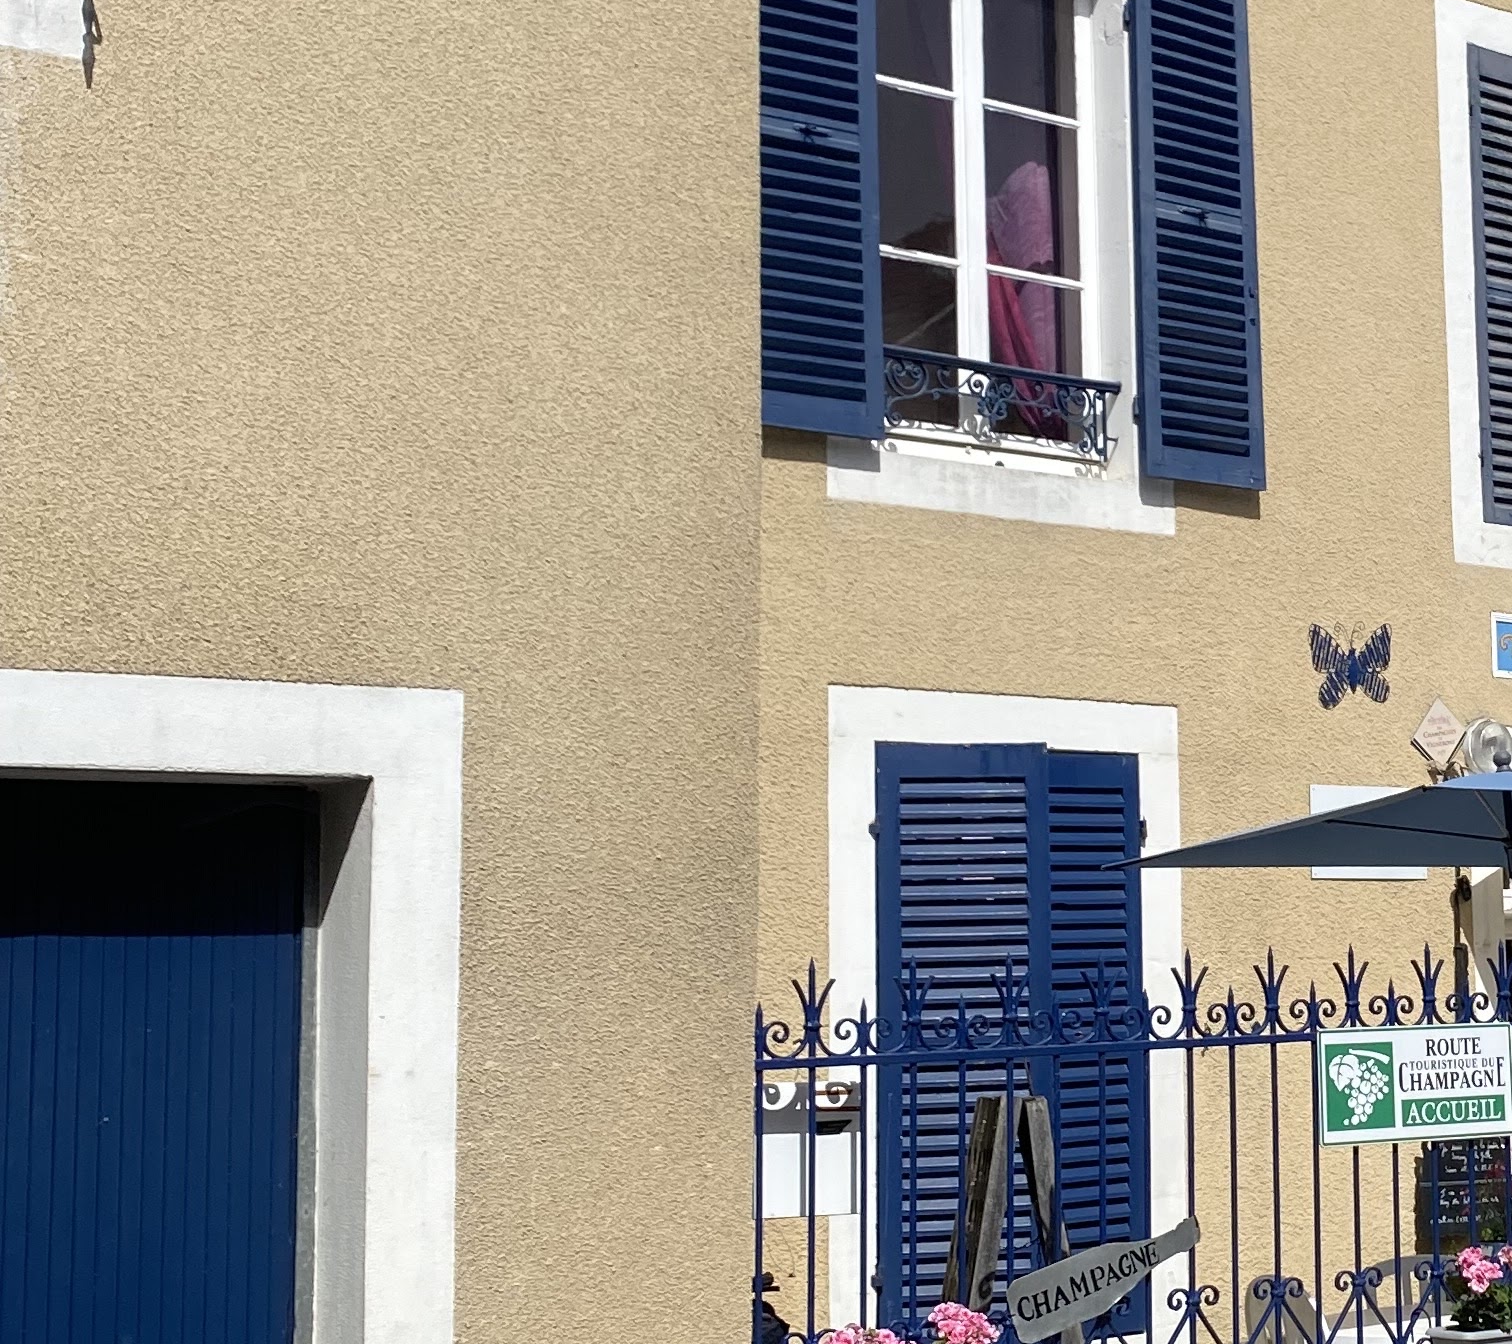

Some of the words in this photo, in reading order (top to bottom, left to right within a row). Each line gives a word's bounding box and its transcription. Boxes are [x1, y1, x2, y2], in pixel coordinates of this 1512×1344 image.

[1425, 1037, 1482, 1057] ROUTE
[1399, 1056, 1506, 1093] CHAMPAGNE
[1410, 1059, 1478, 1070] TOURISTIQUE
[1481, 1057, 1495, 1068] DU
[1406, 1098, 1502, 1125] ACCUEIL
[1017, 1241, 1160, 1322] CHAMPAGNE
